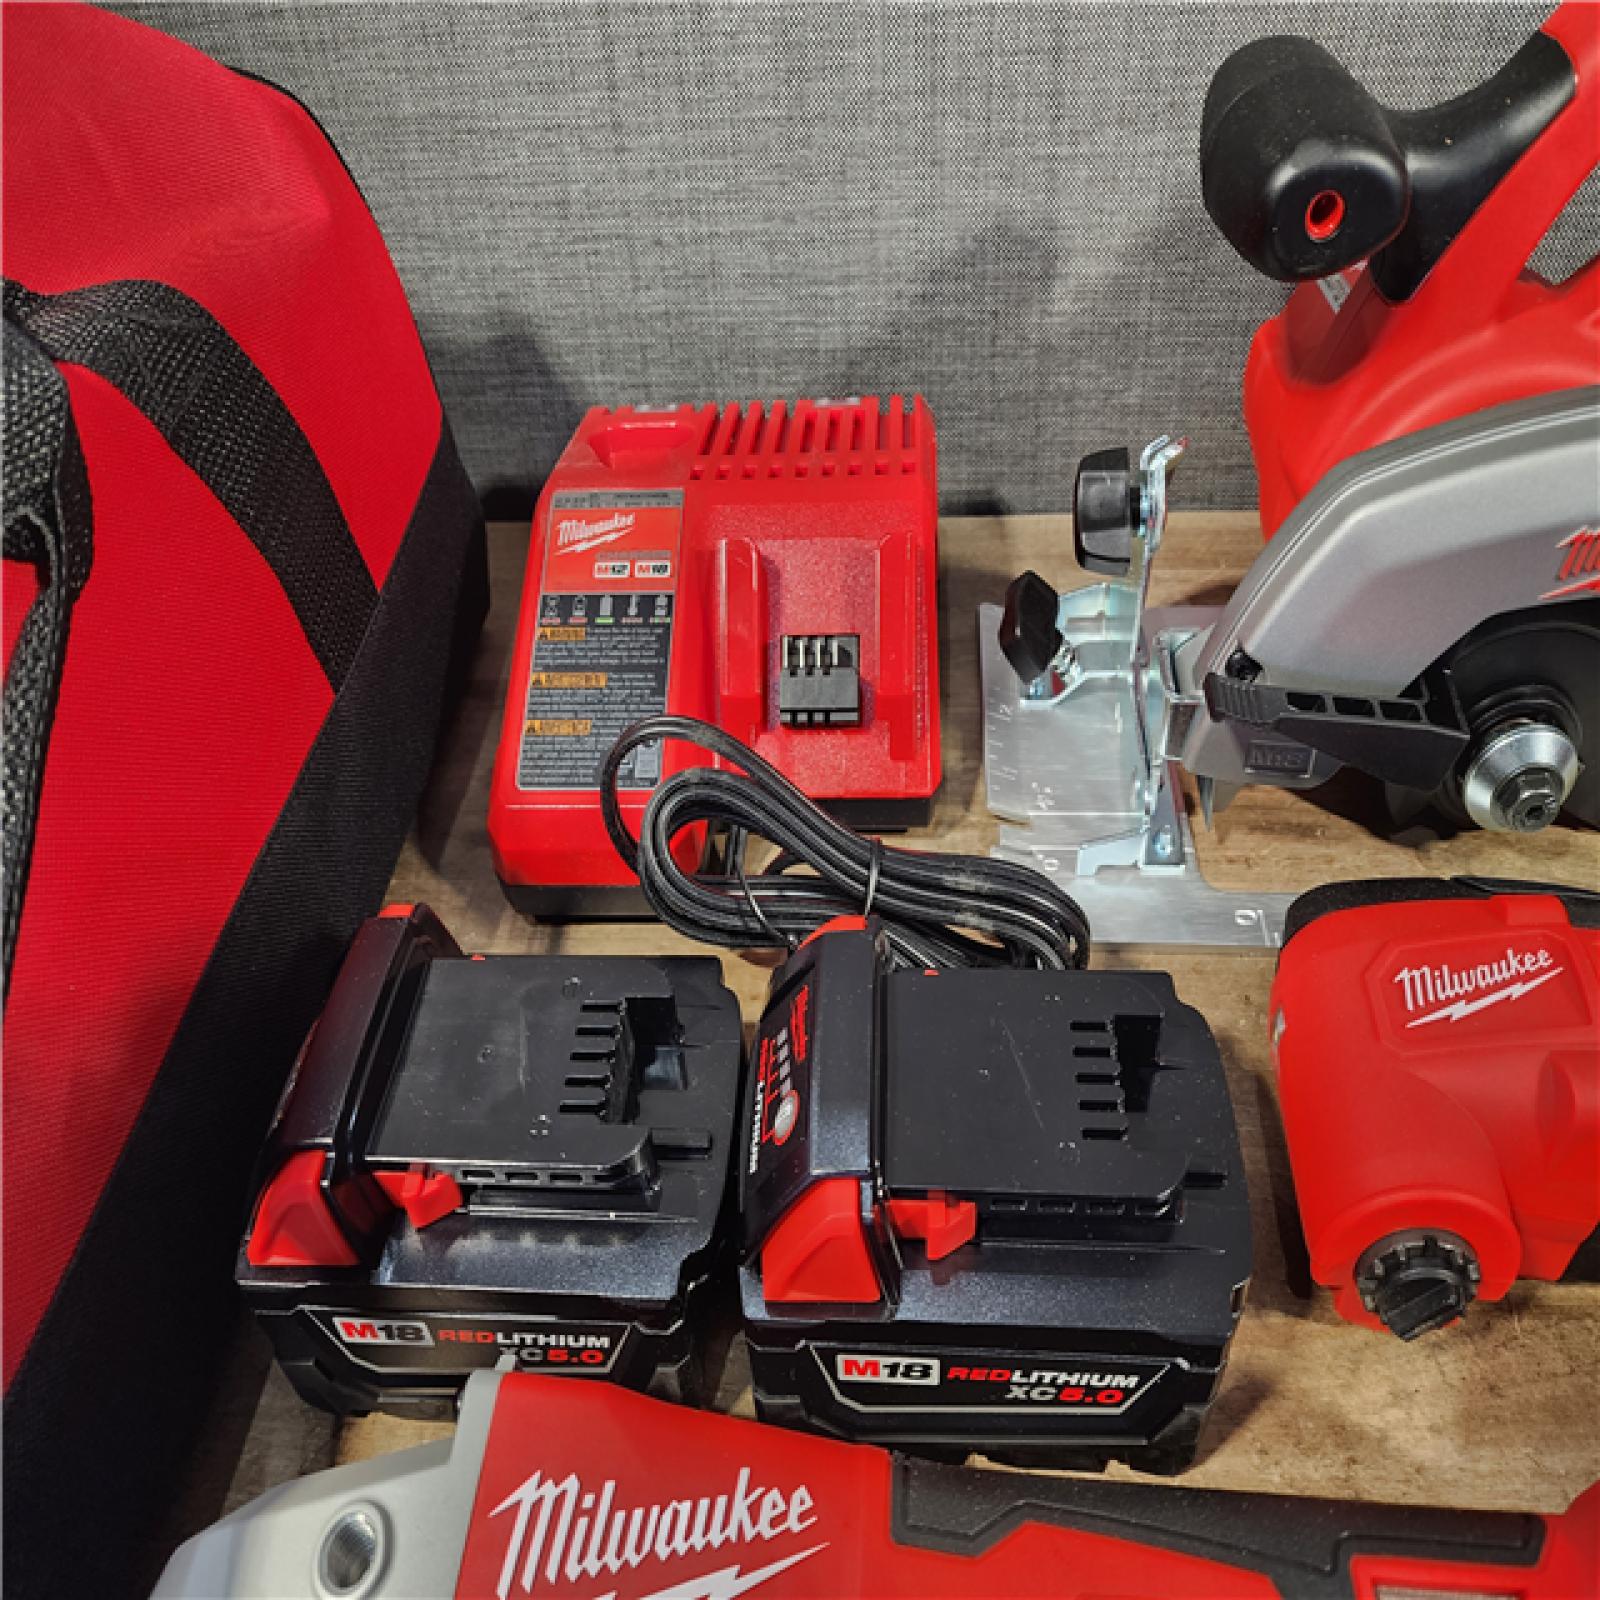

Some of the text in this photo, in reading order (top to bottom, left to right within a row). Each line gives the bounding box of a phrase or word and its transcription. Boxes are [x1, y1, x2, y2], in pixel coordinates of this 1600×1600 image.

[1394, 947, 1553, 1011] Milwaukee
[340, 1321, 611, 1349] M18 REDLITHIUM
[843, 1359, 1141, 1389] M18 REDLITHIUM
[1004, 1385, 1124, 1404] XC5.0
[488, 1466, 818, 1600] Milwaukee
